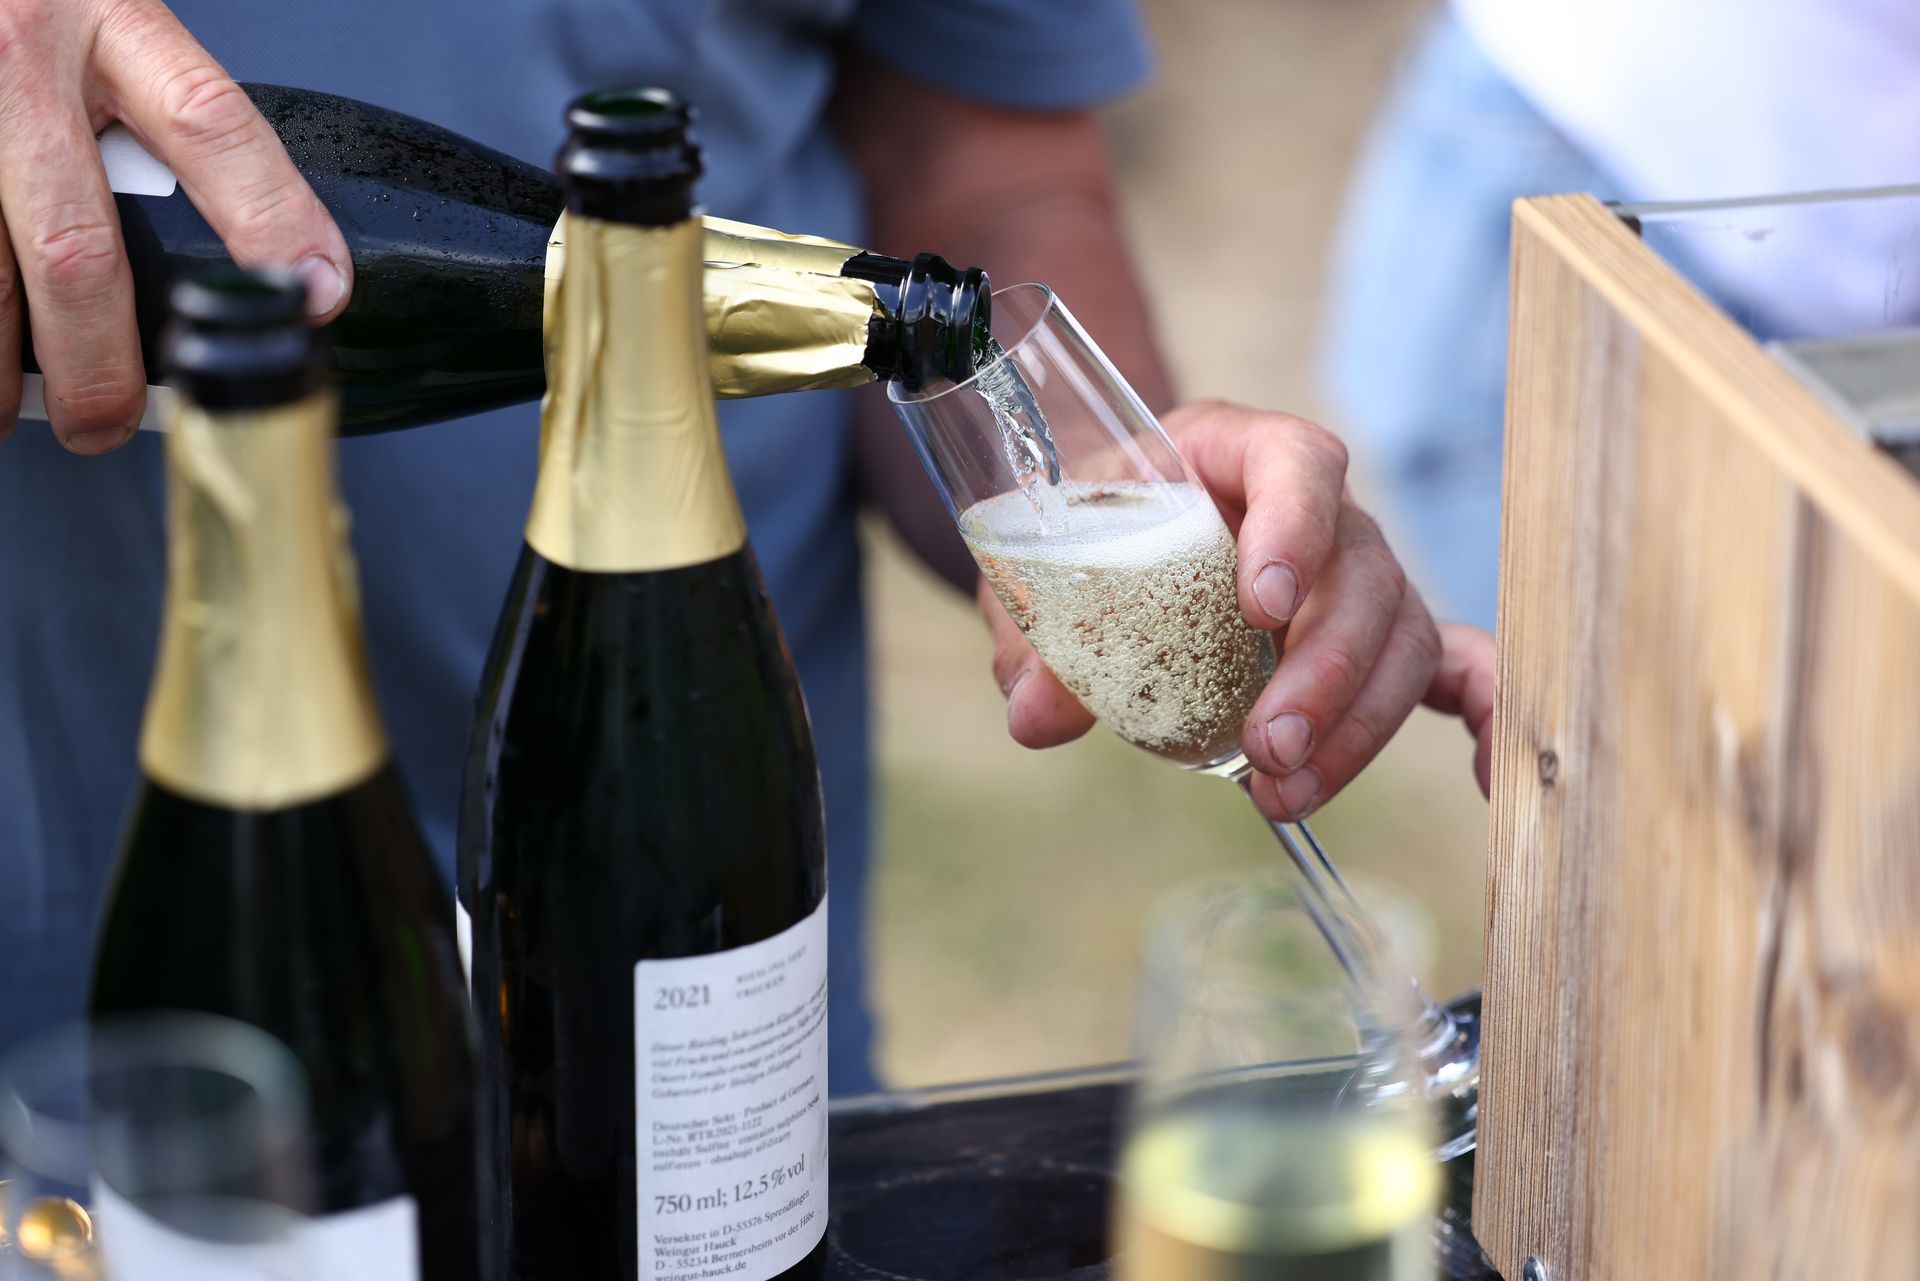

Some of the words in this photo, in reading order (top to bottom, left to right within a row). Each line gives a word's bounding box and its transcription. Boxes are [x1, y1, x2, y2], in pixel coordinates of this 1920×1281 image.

[654, 983, 710, 1011] 2021
[652, 1119, 709, 1132] Deutscher
[712, 1112, 735, 1125] Sekt
[743, 1097, 777, 1117] Product
[779, 1091, 787, 1104] of
[738, 1126, 775, 1145] contains
[654, 1193, 692, 1215] 750
[696, 1188, 728, 1210] ml;
[787, 1152, 805, 1179] vol
[654, 1233, 707, 1245] Versektet
[709, 1229, 720, 1239] in
[722, 1216, 763, 1236] D-55576
[764, 1190, 810, 1223] Sprendlingen
[654, 1246, 700, 1258] Weingut
[704, 1237, 737, 1252] Hauck
[655, 1259, 666, 1271] D
[676, 1256, 709, 1269] 55234
[711, 1238, 773, 1264] Bermersheim
[774, 1231, 787, 1244] vor
[788, 1223, 799, 1237] der
[800, 1210, 815, 1228] Höhe
